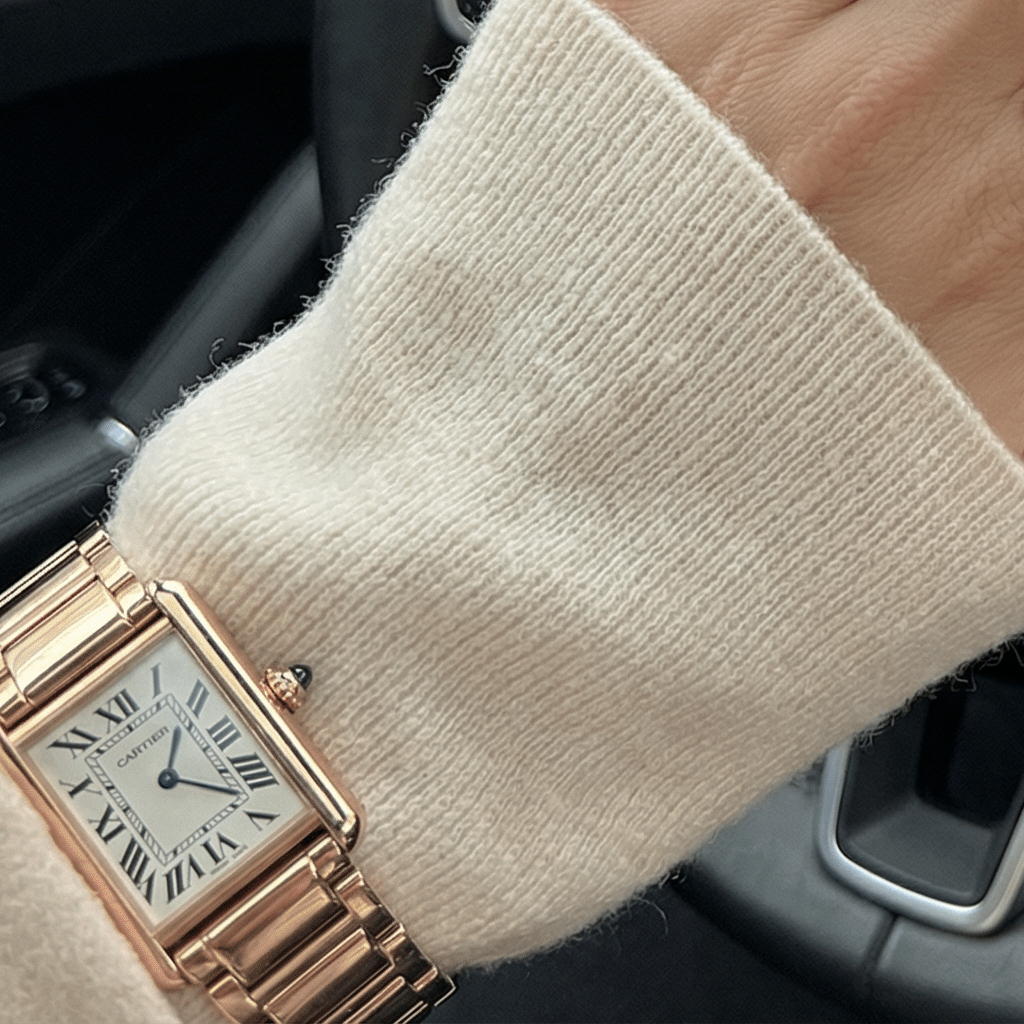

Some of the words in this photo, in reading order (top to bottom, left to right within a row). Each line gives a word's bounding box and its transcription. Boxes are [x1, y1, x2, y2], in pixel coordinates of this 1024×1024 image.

[93, 688, 141, 734] XII
[186, 678, 210, 719] II
[46, 727, 101, 759] XI
[117, 726, 170, 767] CARTIER
[207, 714, 242, 752] III
[58, 773, 103, 799] X
[227, 751, 280, 791] IIII
[243, 810, 280, 832] V
[200, 831, 240, 865] VI
[163, 853, 205, 904] VII
